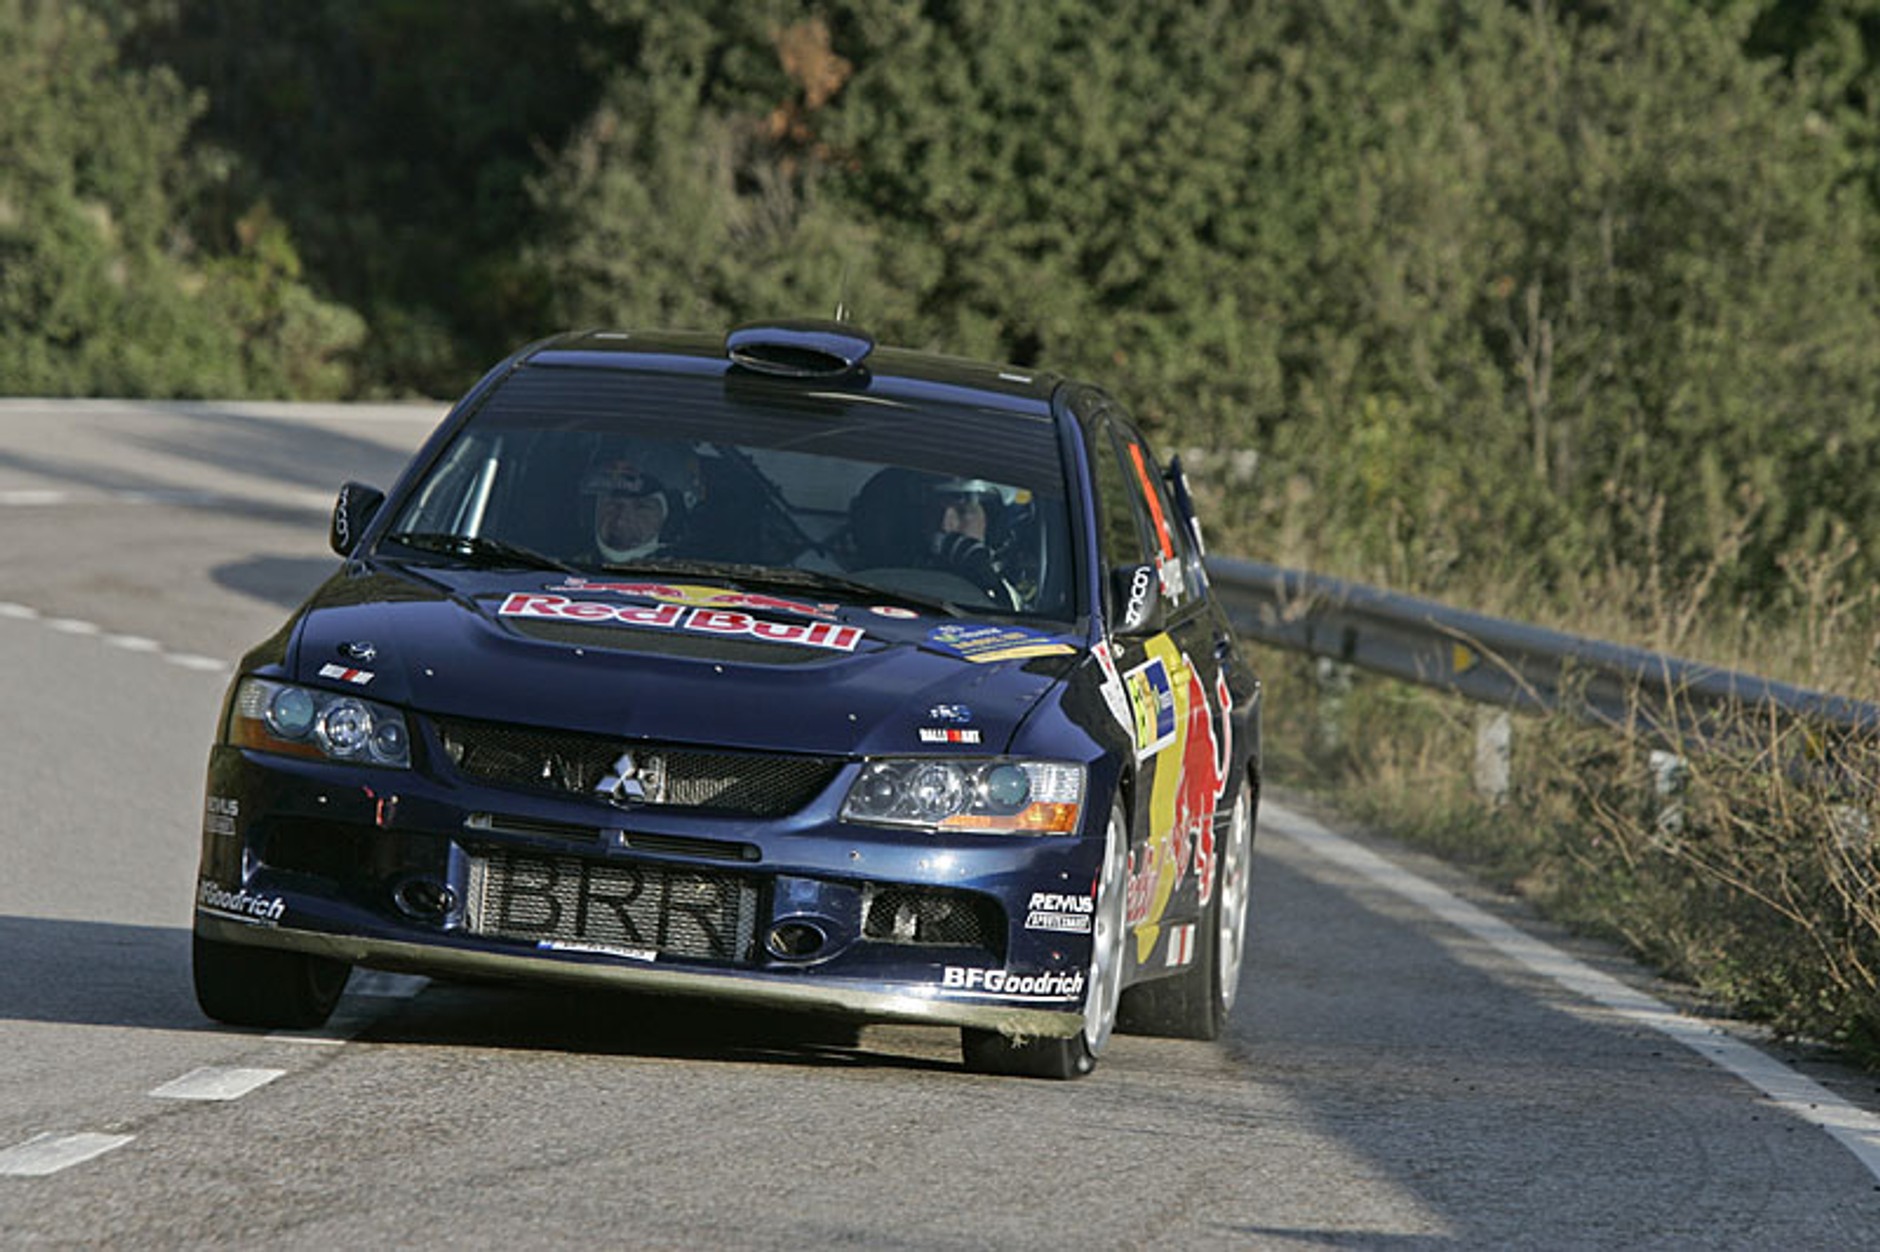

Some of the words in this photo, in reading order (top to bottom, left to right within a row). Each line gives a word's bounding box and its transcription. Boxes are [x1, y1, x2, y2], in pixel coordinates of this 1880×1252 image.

[499, 593, 686, 629] Red
[684, 608, 866, 652] Bull
[500, 852, 727, 951] BRR
[1028, 892, 1094, 913] REMUS
[943, 966, 1085, 995] BFGoodrich
